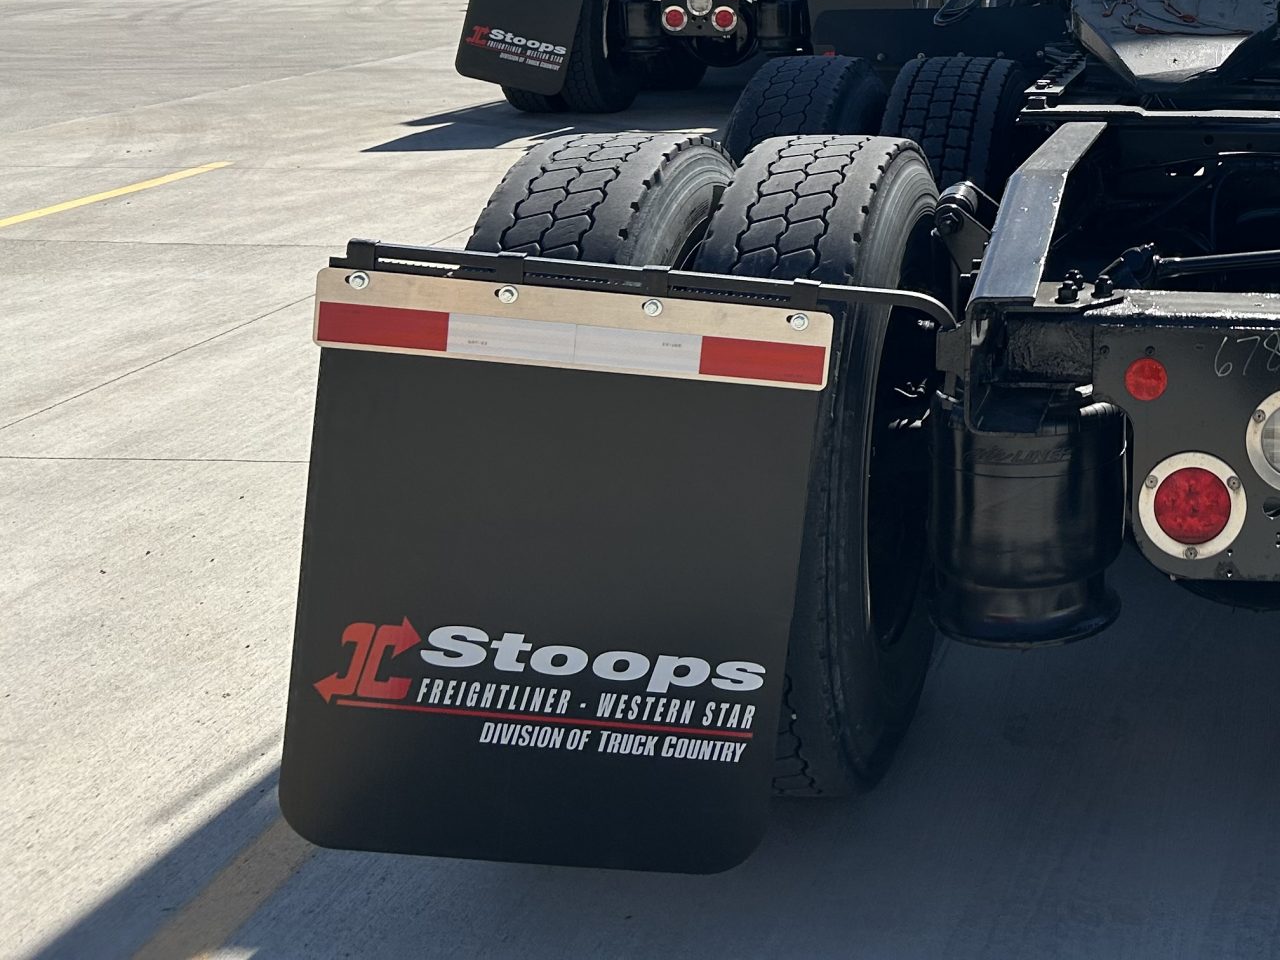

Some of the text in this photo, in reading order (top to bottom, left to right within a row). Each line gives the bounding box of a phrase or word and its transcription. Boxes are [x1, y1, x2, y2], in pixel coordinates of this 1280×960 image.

[489, 29, 567, 54] Stoops
[420, 625, 767, 694] Stoops
[416, 678, 572, 715] FREIGHTLINER
[596, 692, 696, 725] WESTERN
[702, 701, 757, 729] STAR
[479, 721, 748, 763] DIVISION OF TRUCK COUNTRY
